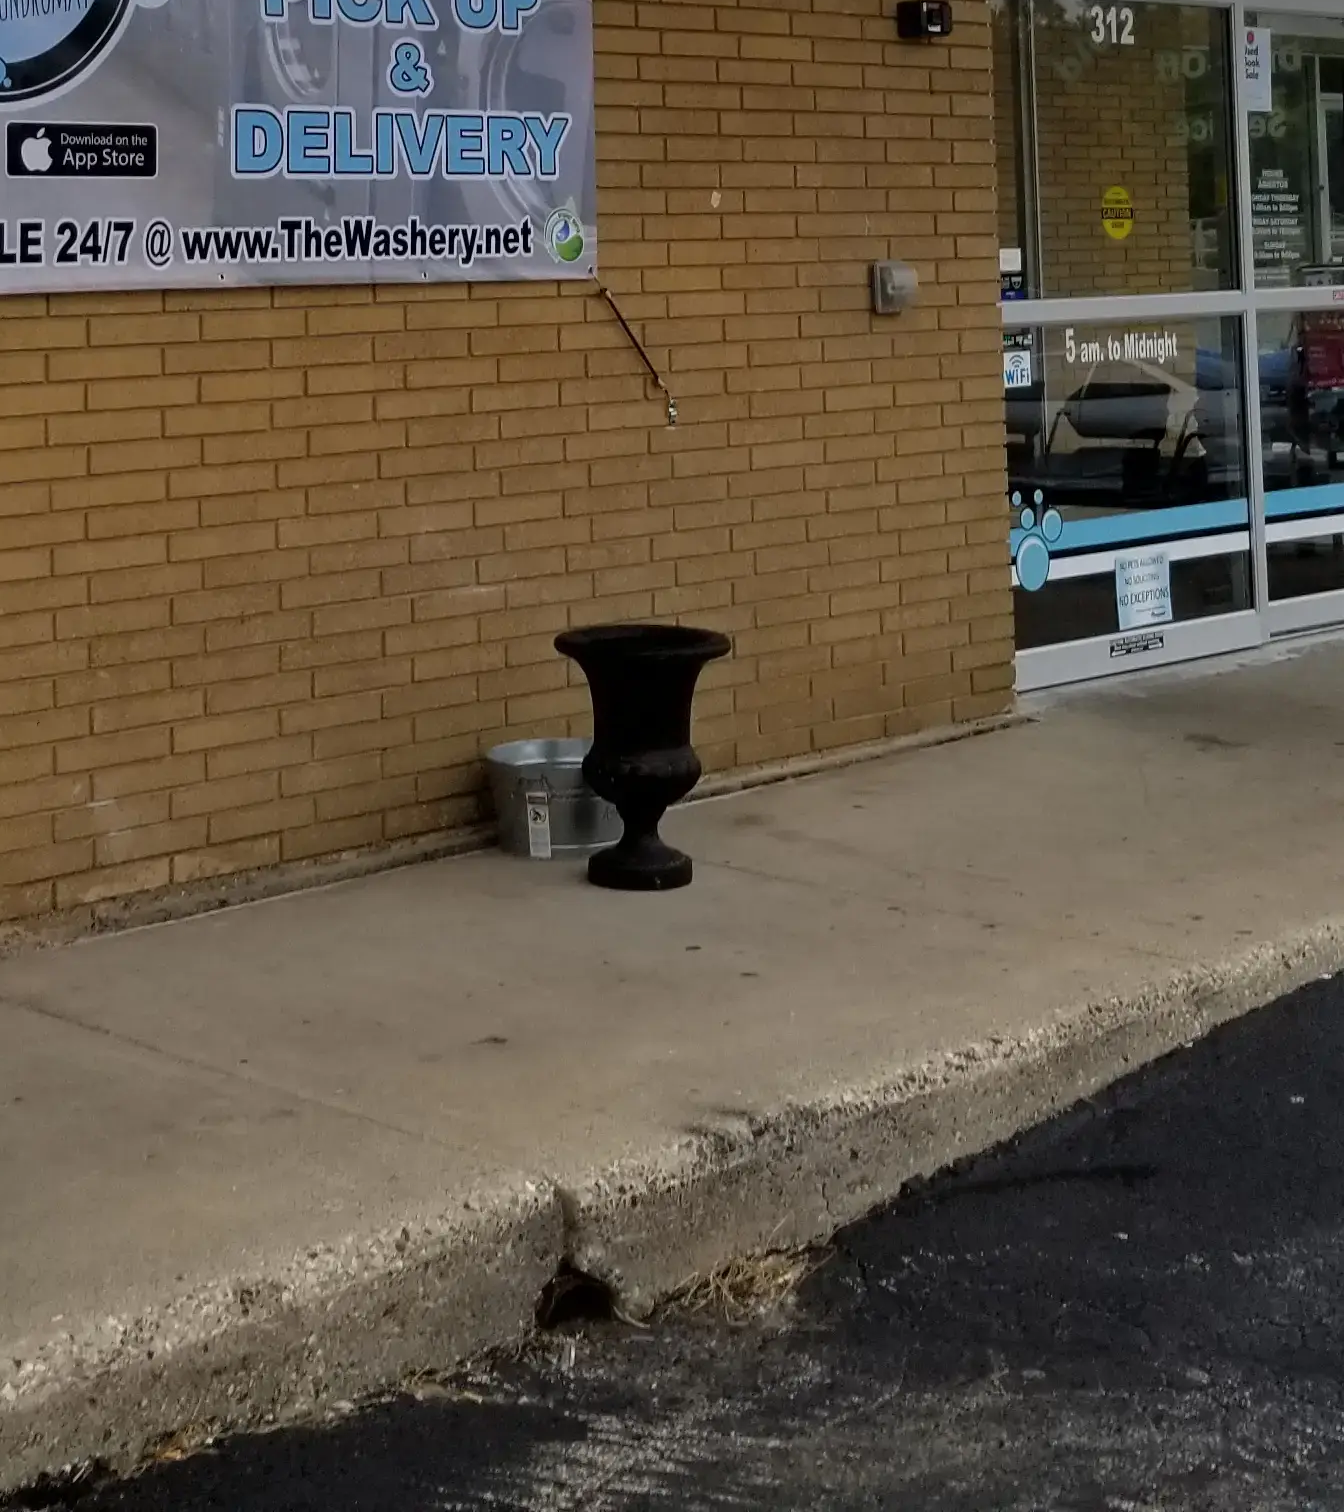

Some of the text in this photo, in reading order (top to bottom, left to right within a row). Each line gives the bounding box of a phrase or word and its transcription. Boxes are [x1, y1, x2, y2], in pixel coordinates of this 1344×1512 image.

[1090, 5, 1135, 45] 312
[389, 42, 431, 92] &
[60, 132, 148, 147] Download on the
[62, 148, 144, 169] App Store
[234, 108, 570, 176] DELIVERY
[56, 220, 134, 263] 24/7
[144, 220, 172, 266] @
[181, 216, 532, 265] www.TheWashery.net
[1065, 328, 1178, 364] 5 am. to Midnight
[1119, 586, 1169, 607] NO EXCEPTIONS
